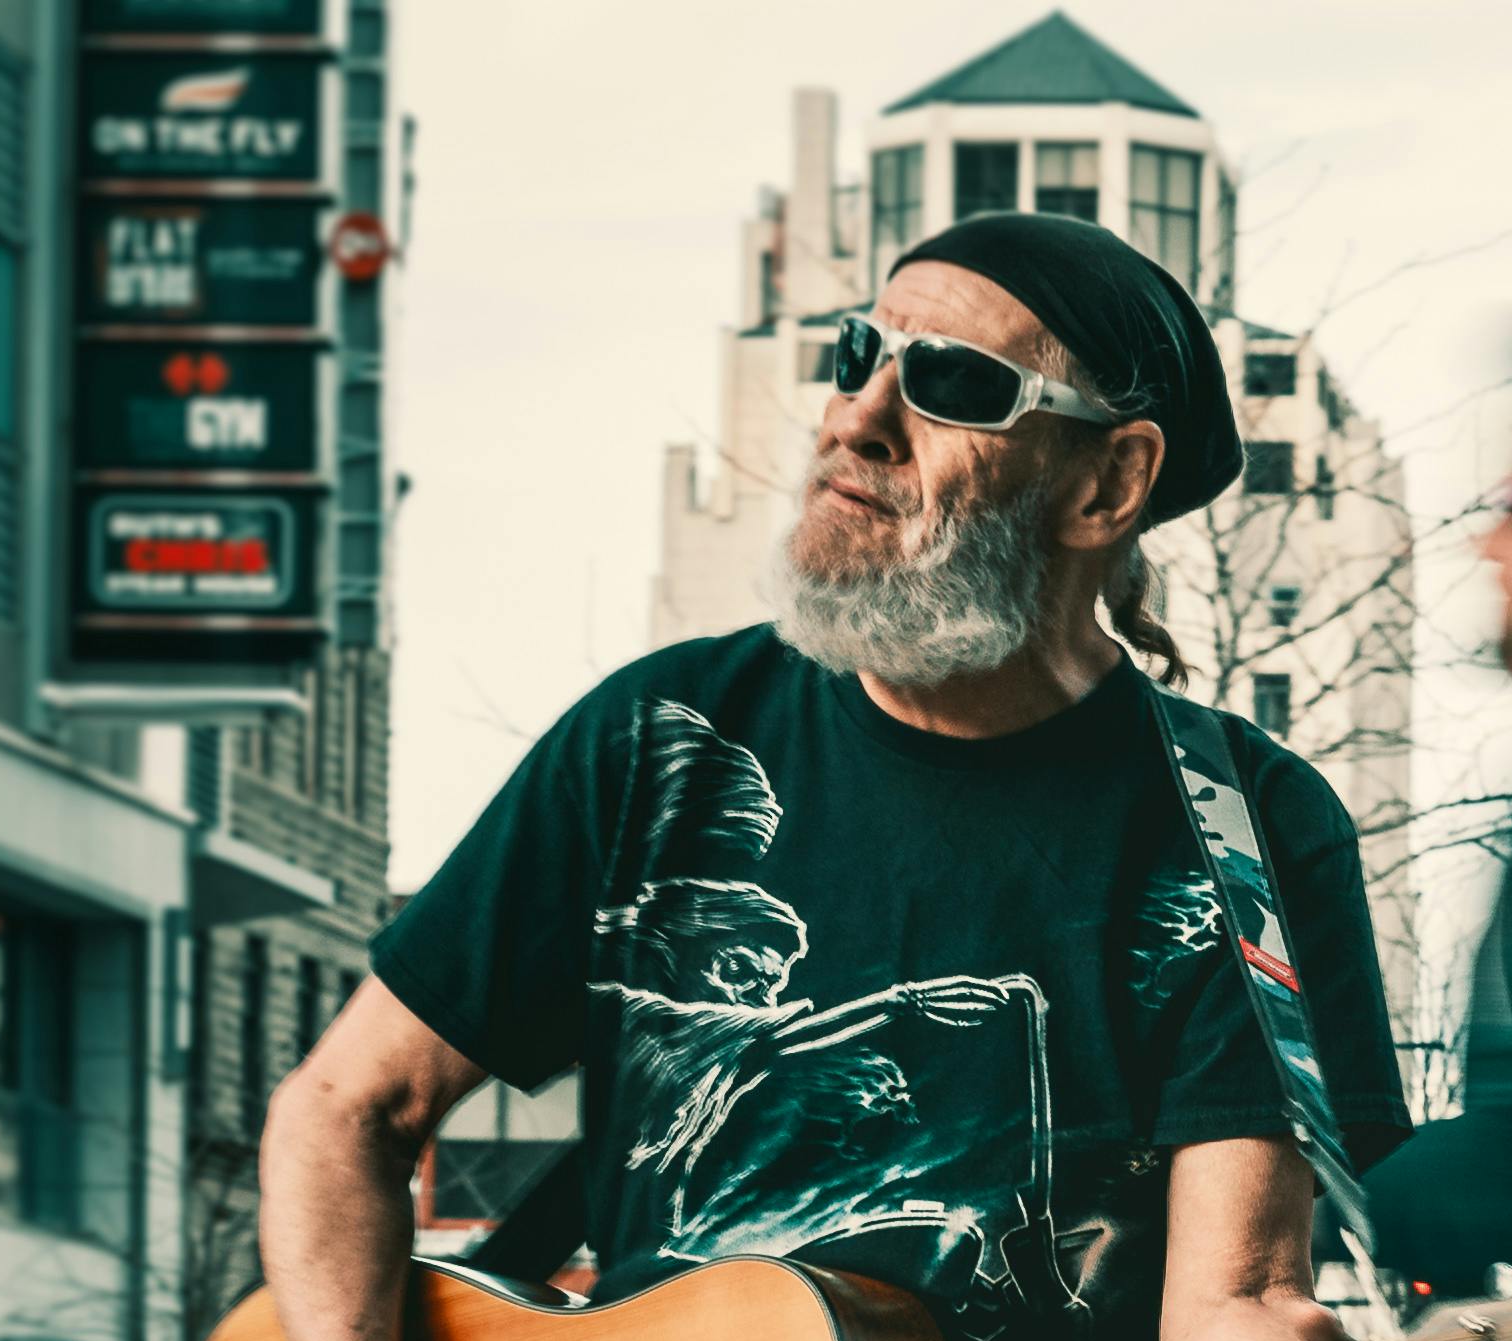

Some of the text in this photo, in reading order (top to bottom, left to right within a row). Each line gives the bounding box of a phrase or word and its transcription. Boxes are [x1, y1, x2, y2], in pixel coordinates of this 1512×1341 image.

[93, 113, 301, 156] ON THE FLY
[107, 215, 199, 263] FLAT
[187, 397, 267, 450] GYM
[125, 538, 269, 574] CHRIS
